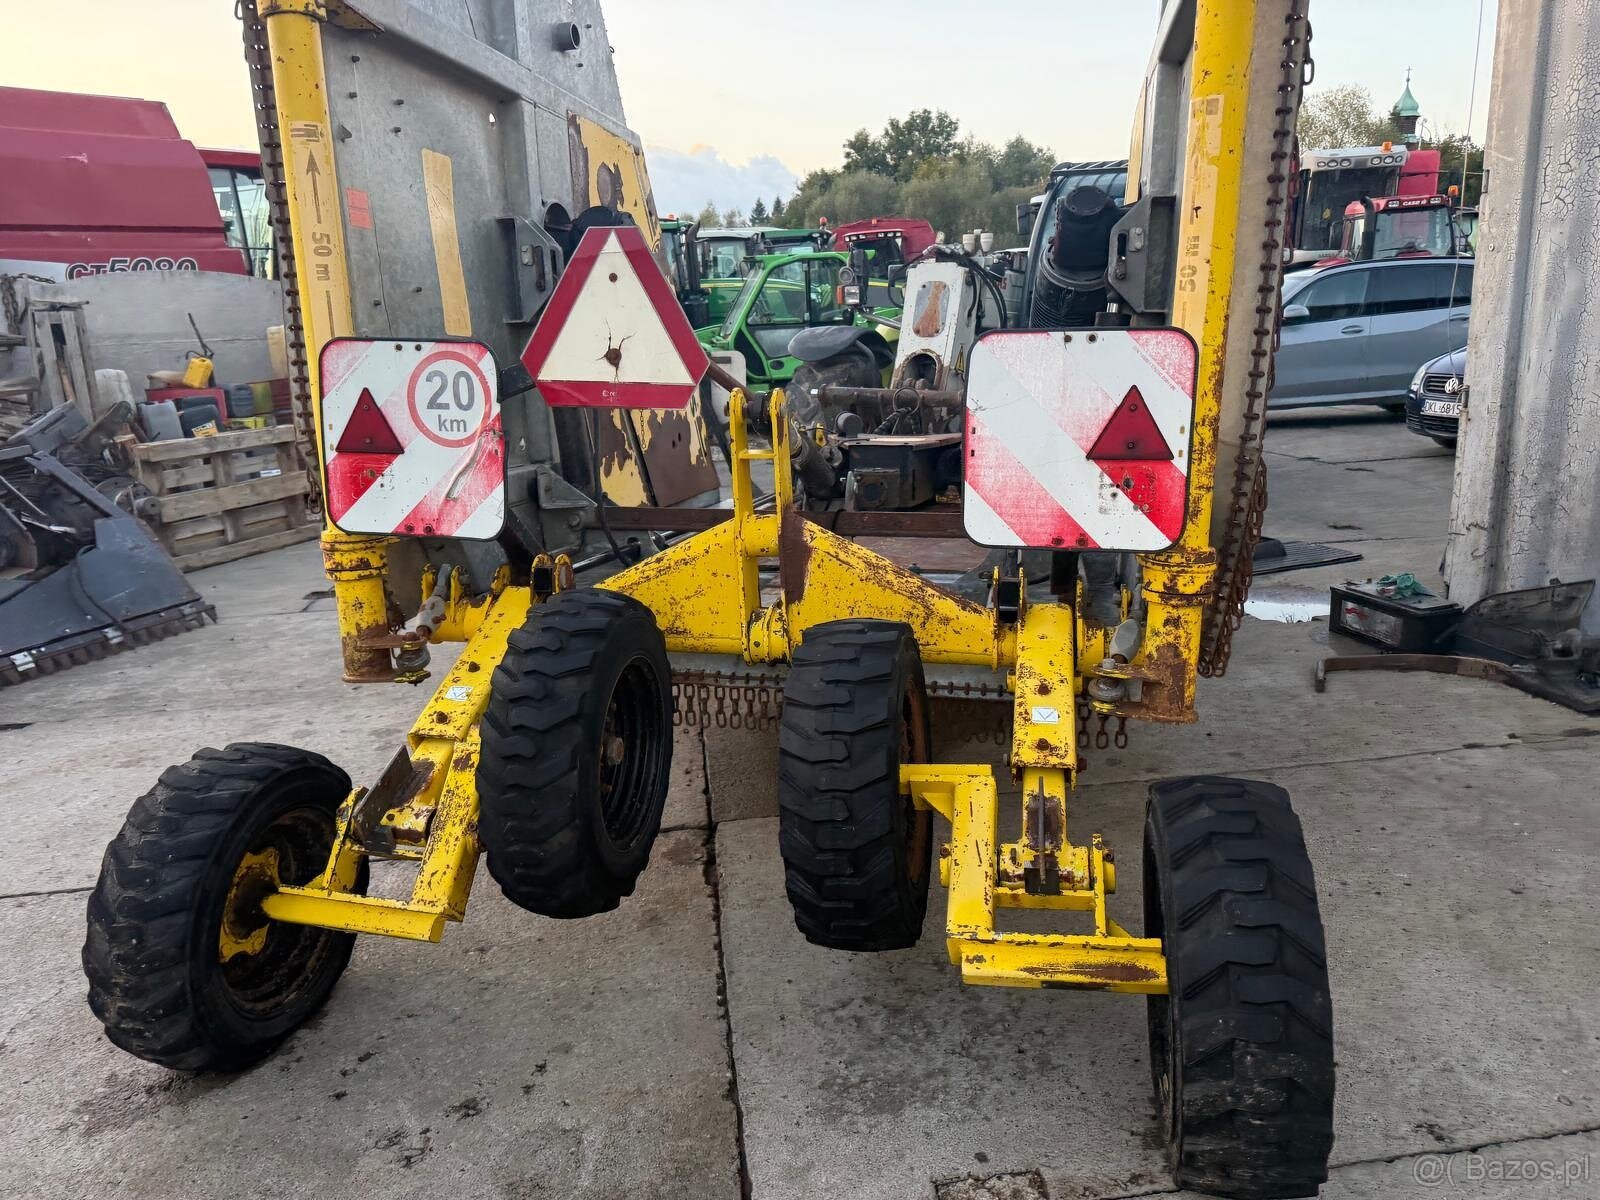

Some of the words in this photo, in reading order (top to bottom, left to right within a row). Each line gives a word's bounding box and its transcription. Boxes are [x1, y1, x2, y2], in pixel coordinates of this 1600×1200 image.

[311, 231, 333, 257] 50
[315, 263, 331, 281] m
[425, 369, 475, 411] 20
[437, 414, 468, 433] km
